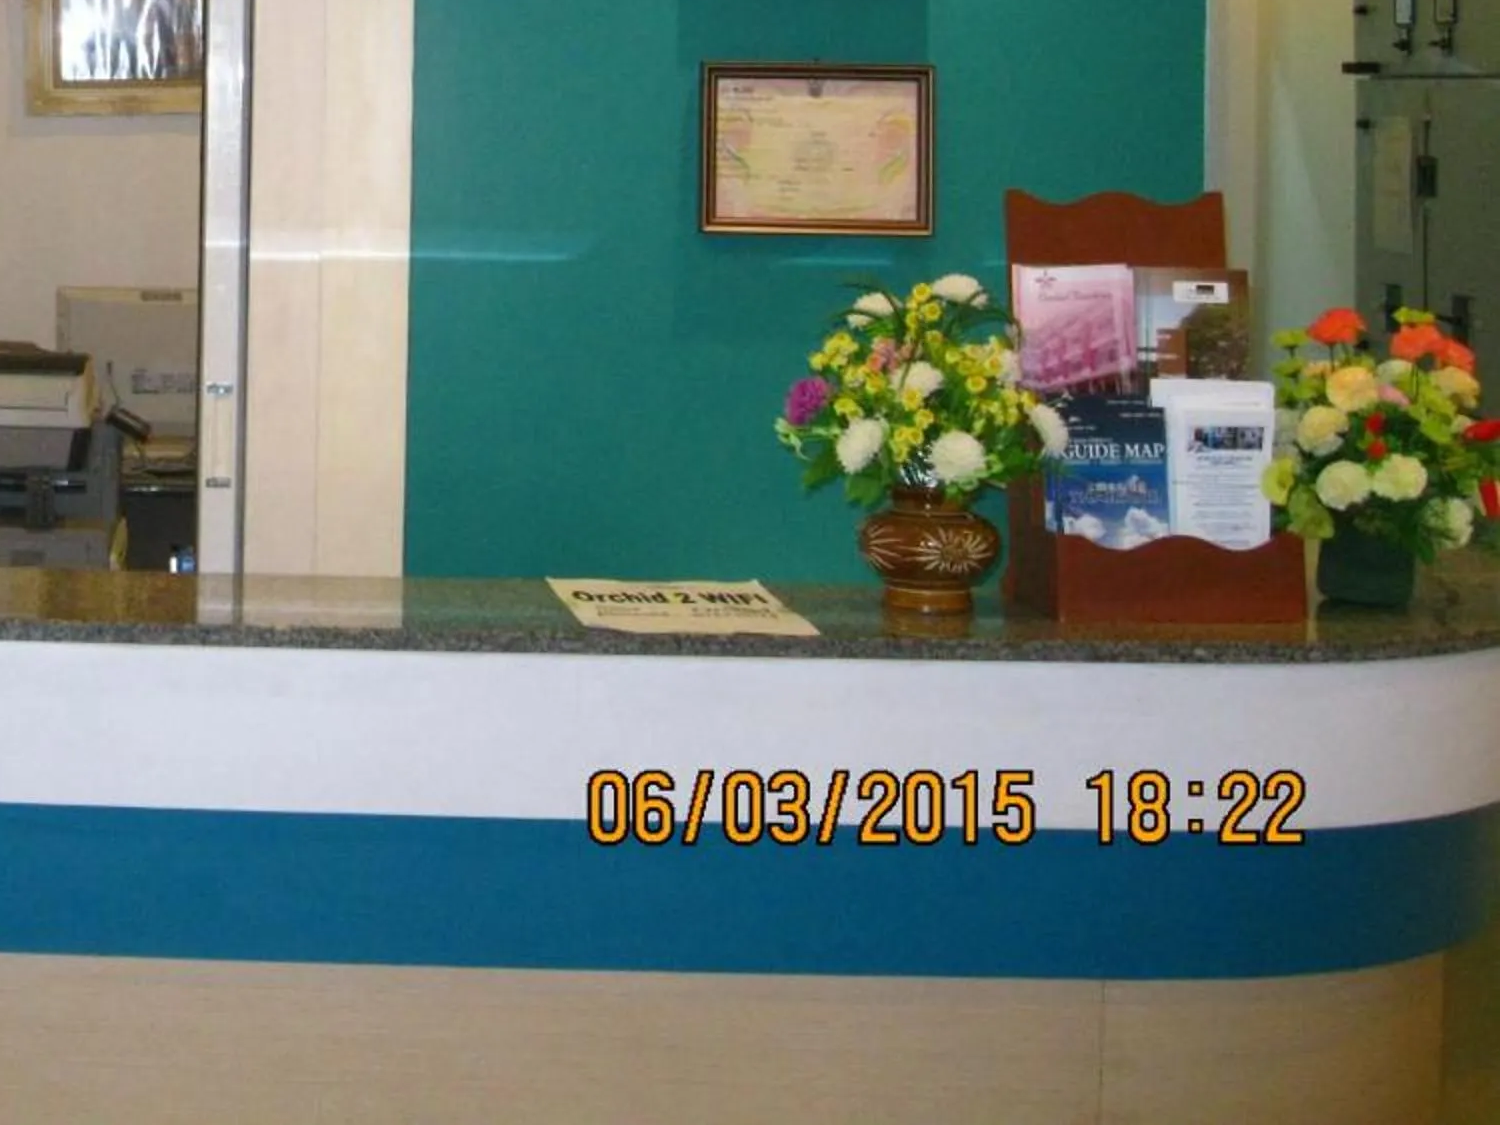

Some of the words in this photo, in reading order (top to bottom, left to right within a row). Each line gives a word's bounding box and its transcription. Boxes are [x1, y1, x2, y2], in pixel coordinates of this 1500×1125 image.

[1061, 443, 1121, 460] GUIDE
[1124, 442, 1166, 459] MAP
[571, 590, 670, 604] Orchid
[674, 592, 696, 605] 2
